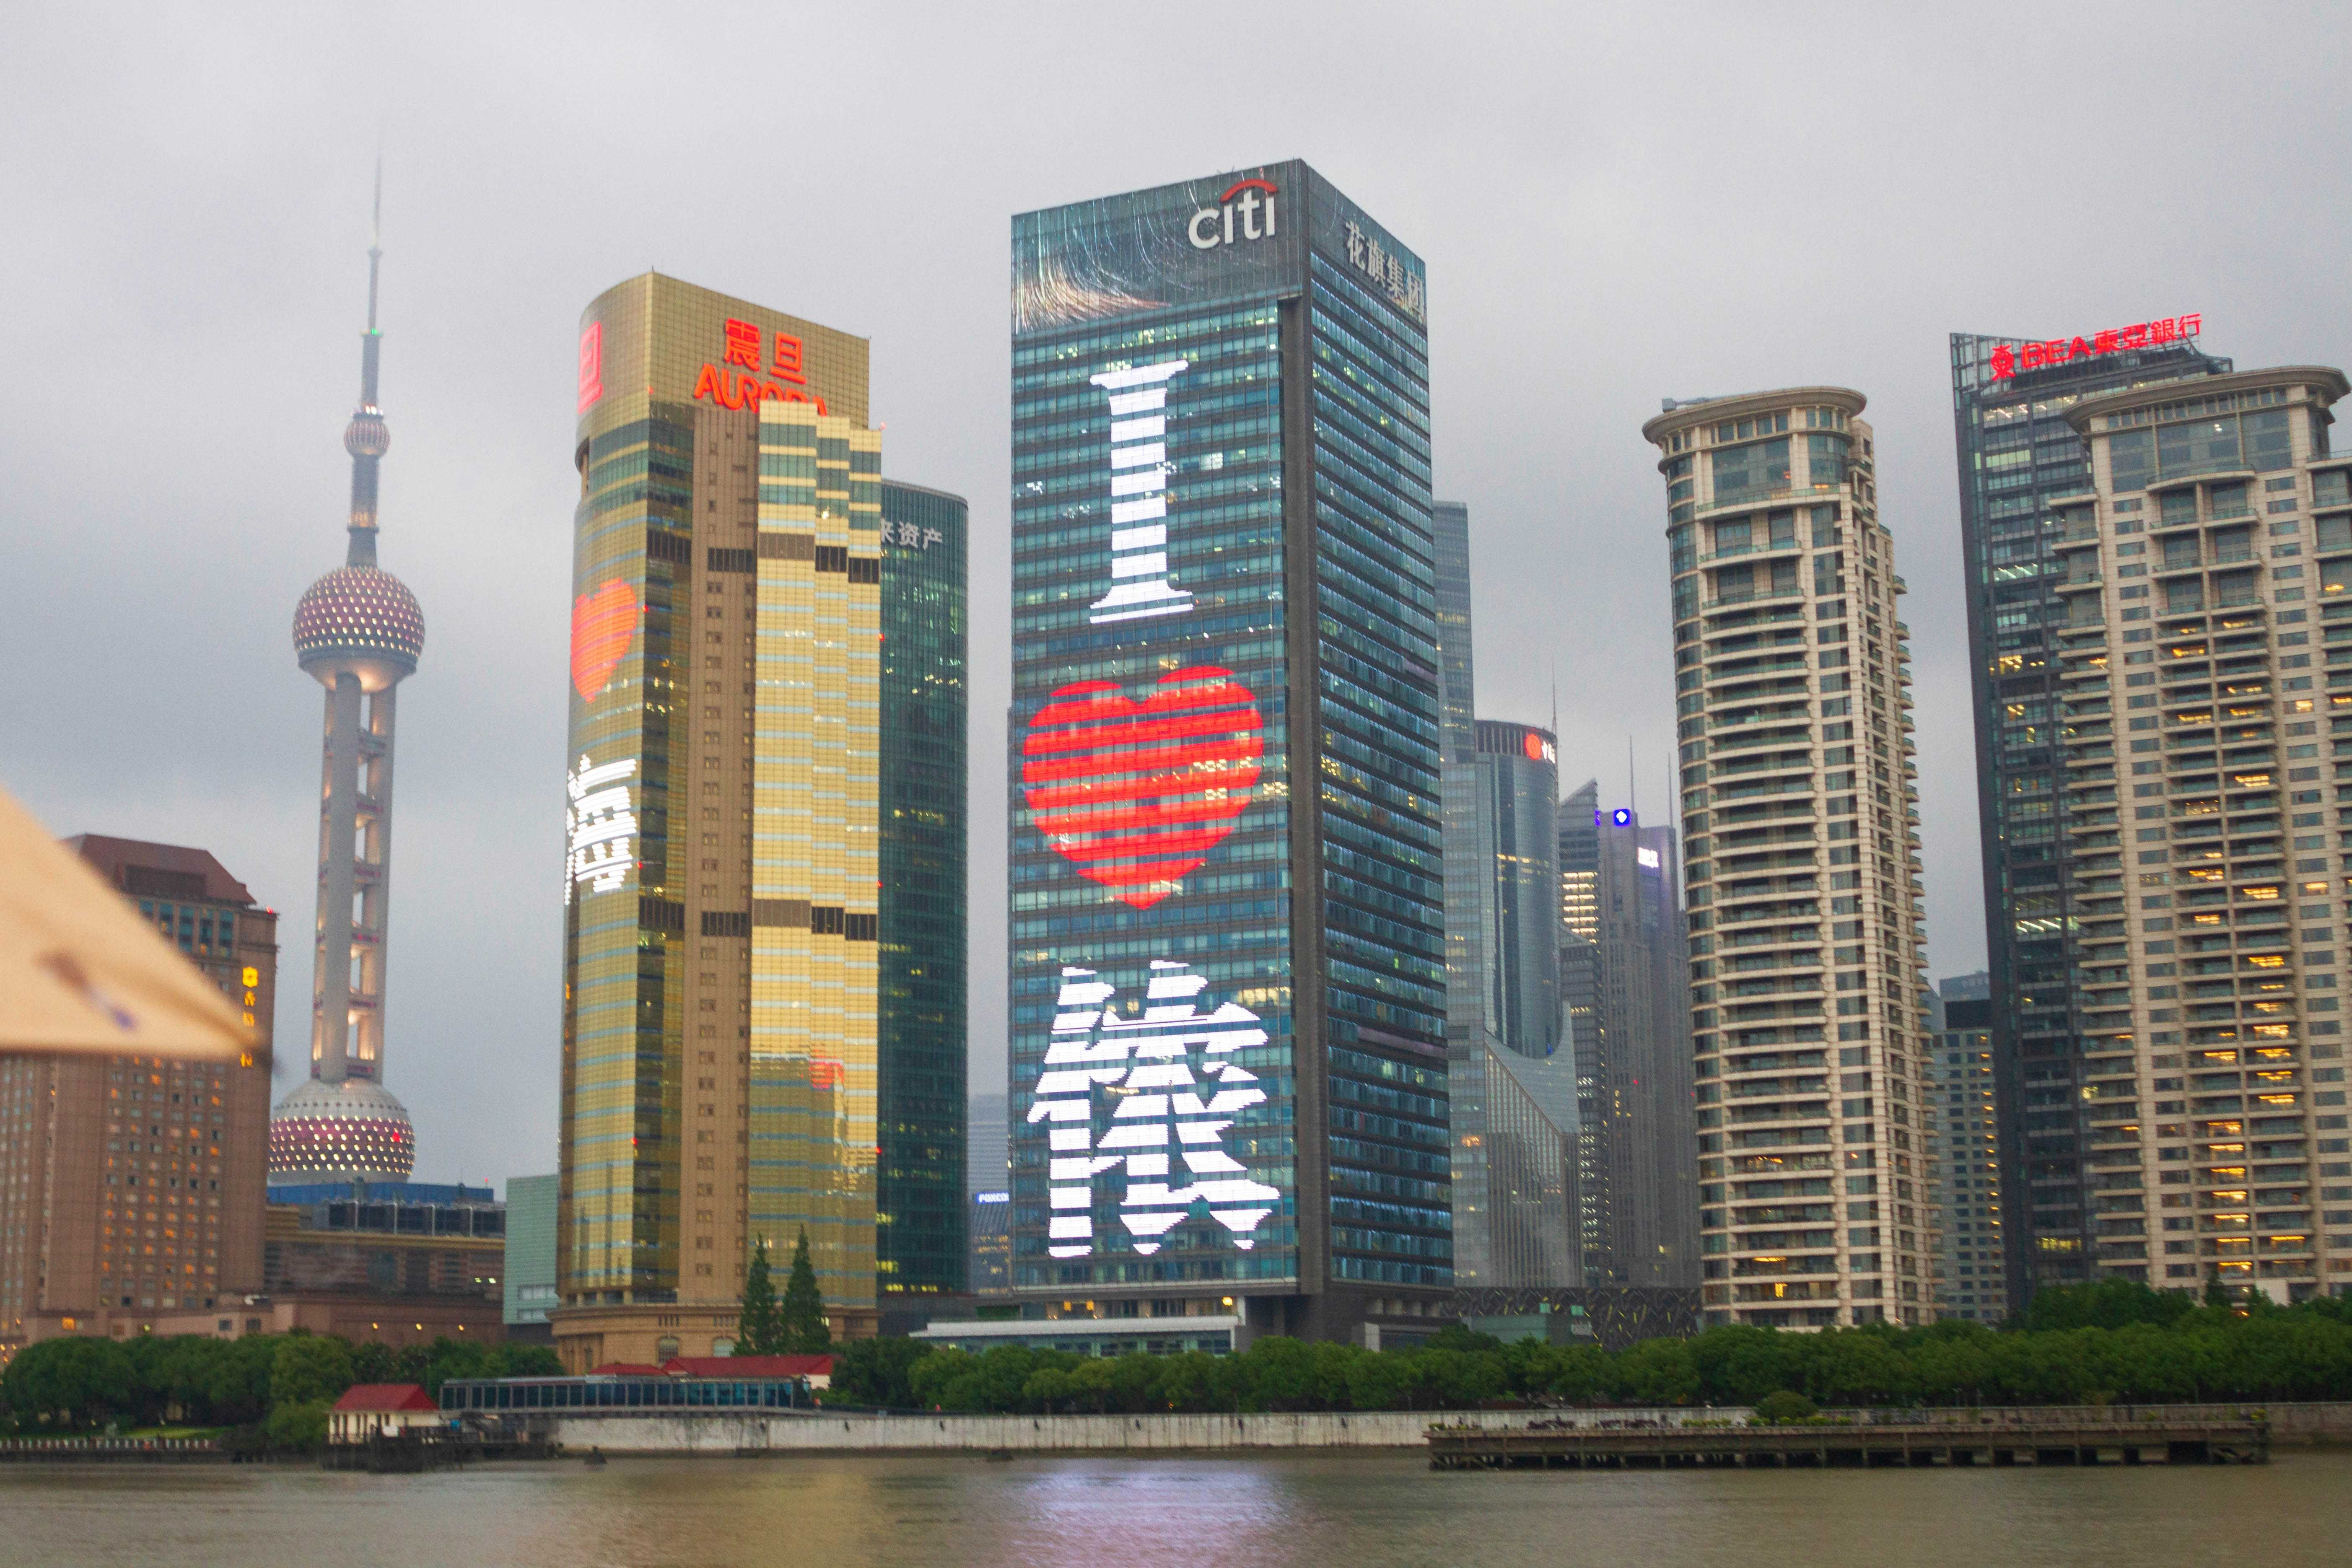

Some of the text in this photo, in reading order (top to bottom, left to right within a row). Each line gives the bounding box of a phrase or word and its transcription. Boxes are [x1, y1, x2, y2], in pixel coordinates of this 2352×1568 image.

[1188, 189, 1276, 249] citi
[1345, 220, 1424, 319] 花旗集团
[724, 317, 806, 385] 震旦
[2021, 313, 2202, 369] BEA 東亞銀行
[1089, 359, 1194, 624] I
